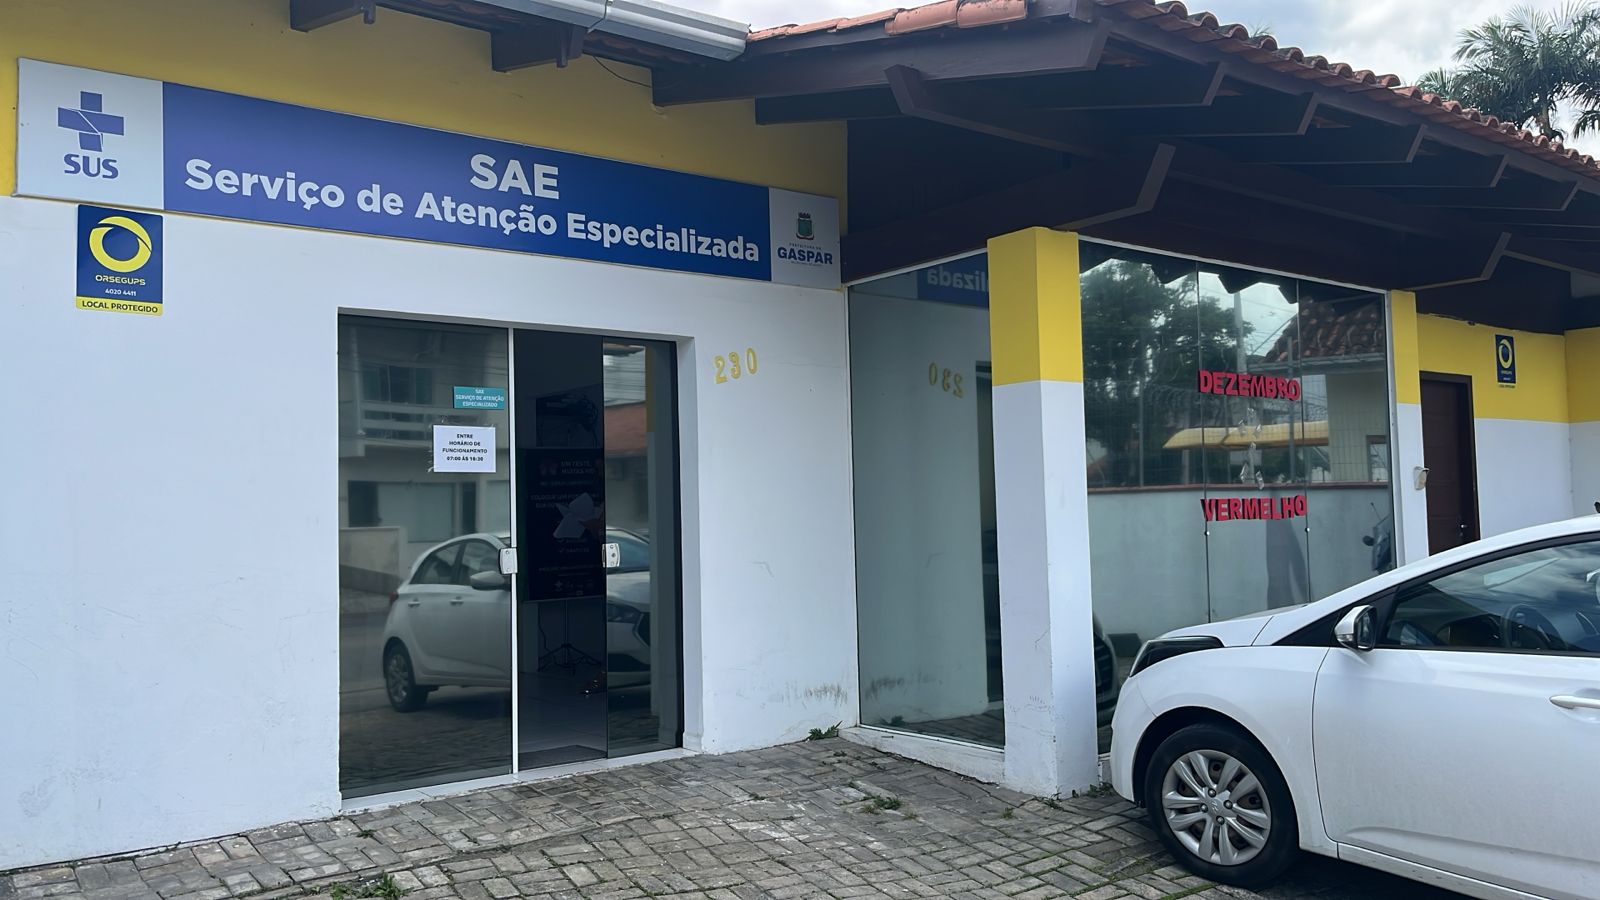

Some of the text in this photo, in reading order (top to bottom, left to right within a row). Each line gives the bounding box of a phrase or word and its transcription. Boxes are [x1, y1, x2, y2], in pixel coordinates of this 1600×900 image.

[63, 153, 119, 179] SUS
[470, 153, 560, 200] SAE
[184, 158, 760, 262] Serviço de Atenção Especializada
[777, 246, 833, 265] GASPAR
[95, 274, 146, 286] ORSEGUPS
[82, 300, 158, 313] LOCAL PROTEGIDO
[714, 347, 758, 385] 230
[1198, 370, 1301, 402] DEZEMBRO
[1200, 494, 1307, 522] VERMELHO
